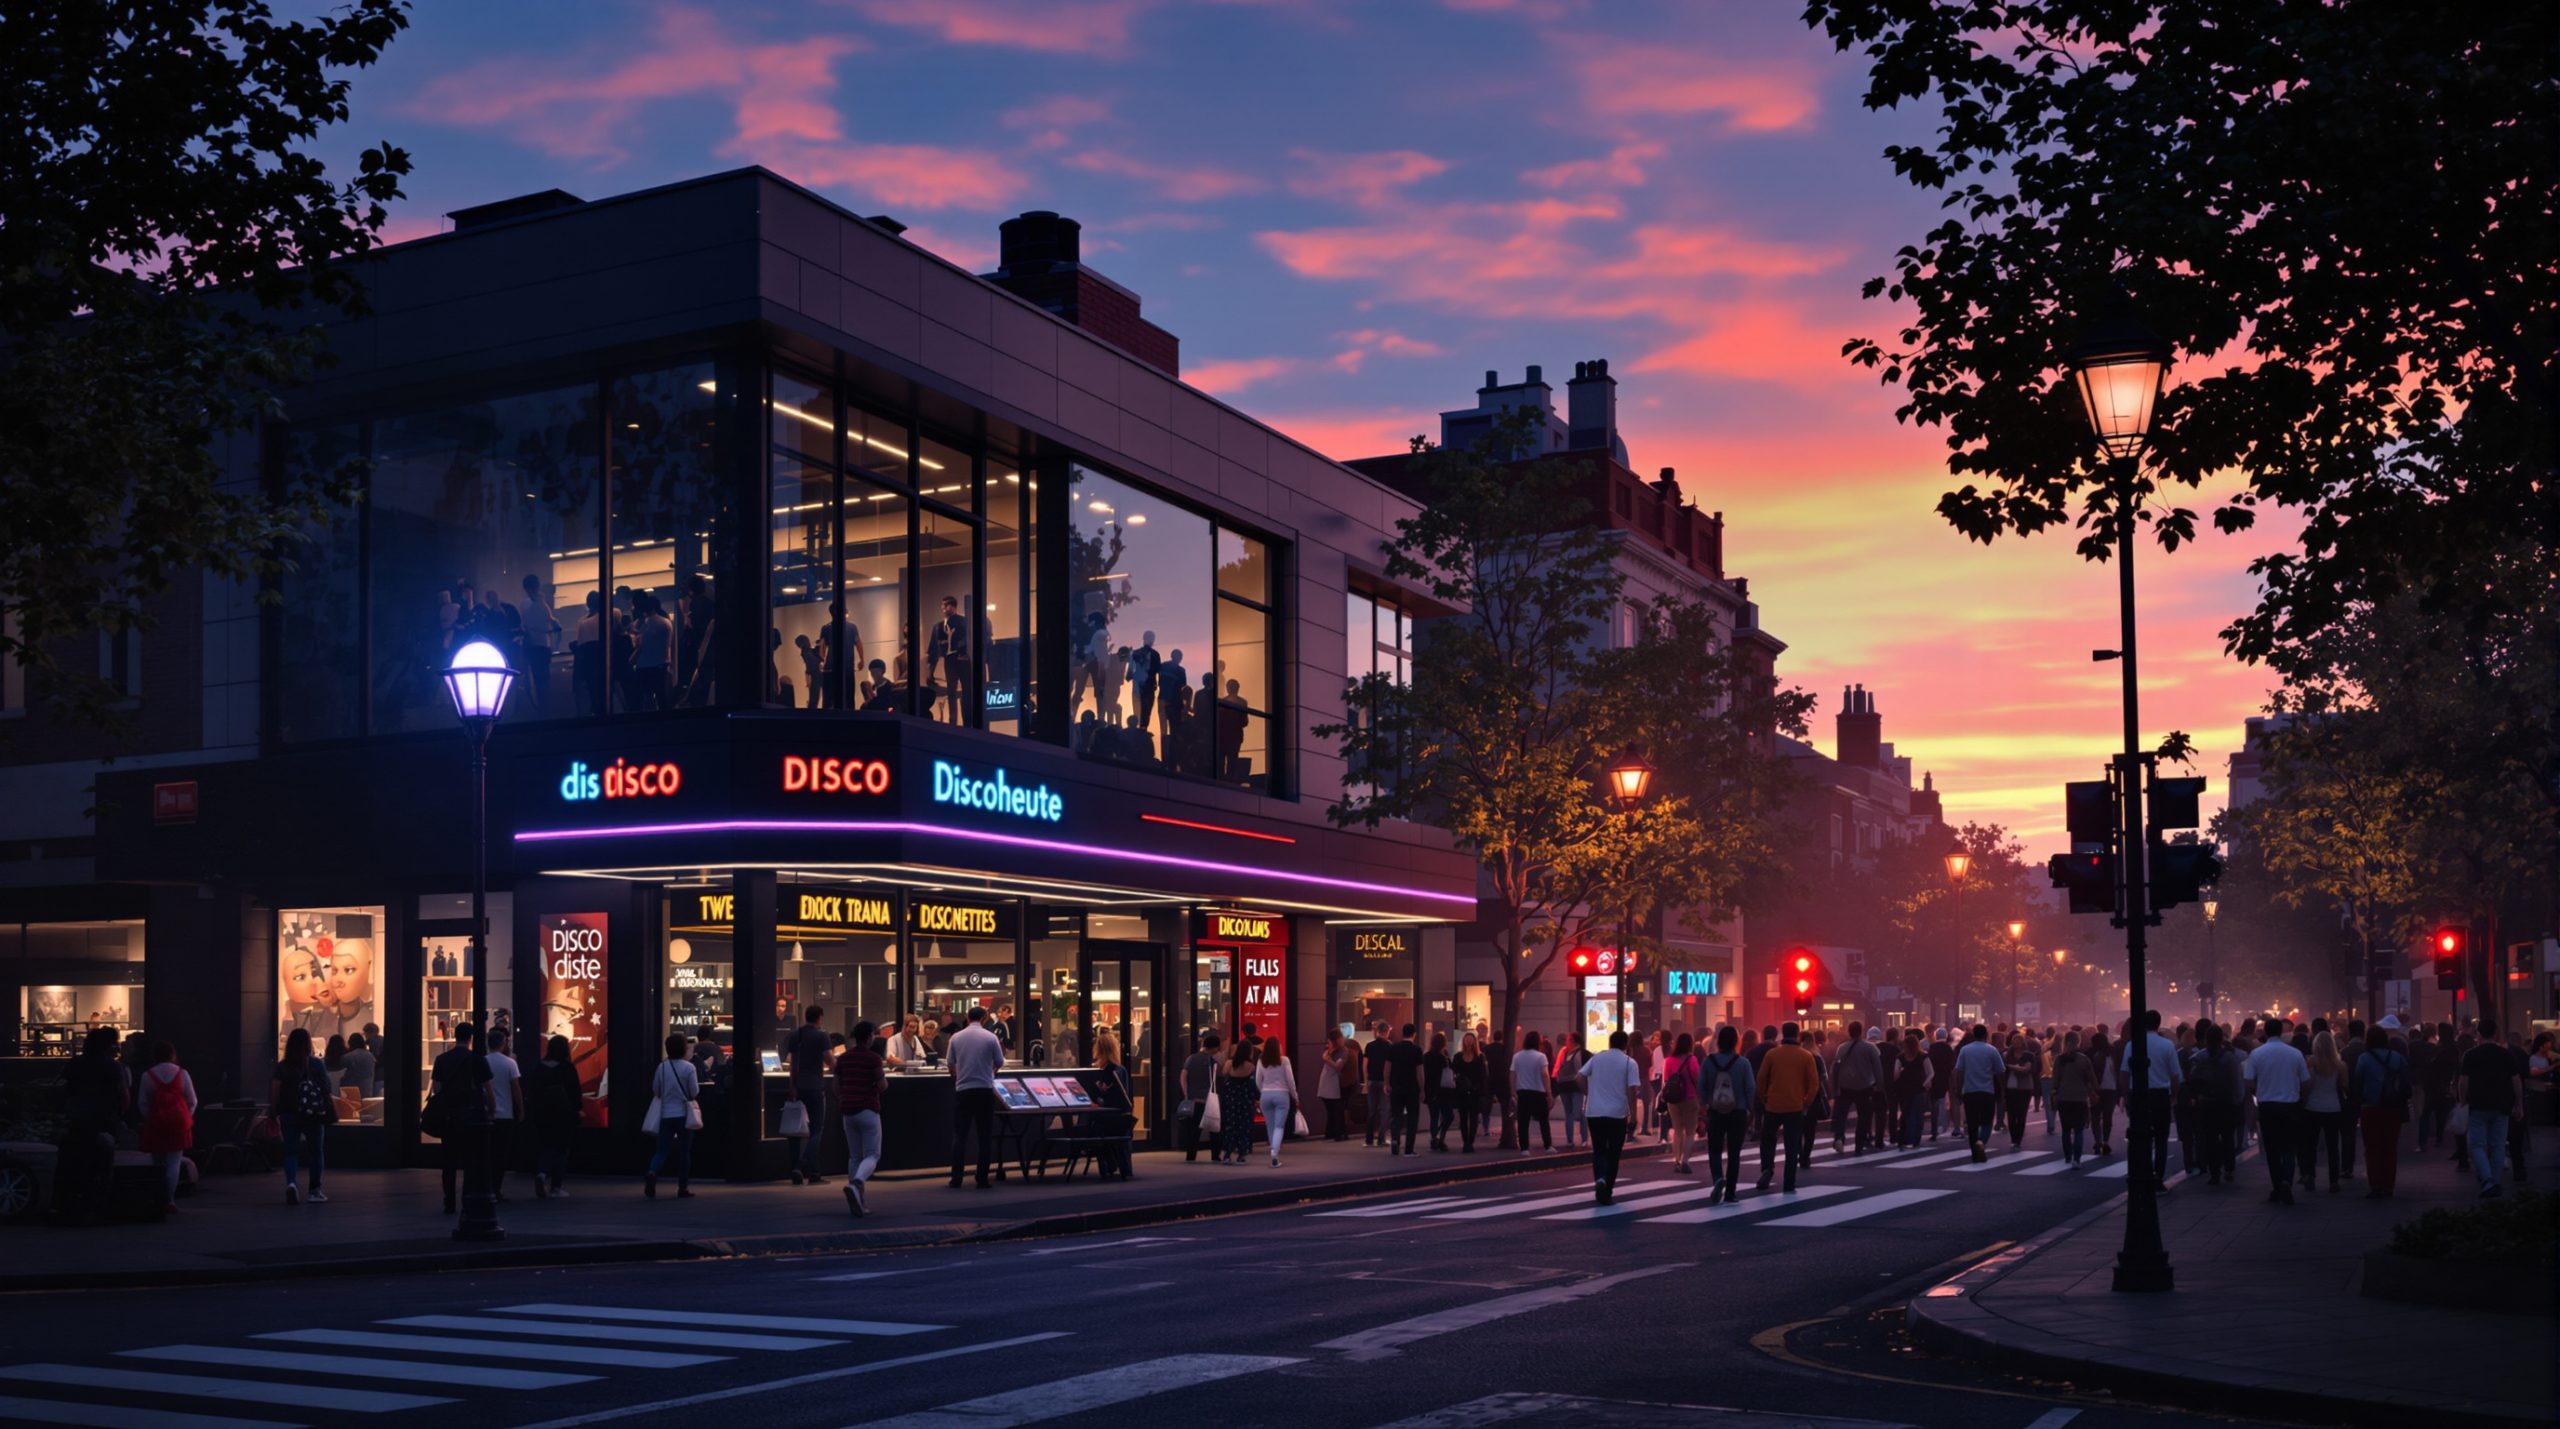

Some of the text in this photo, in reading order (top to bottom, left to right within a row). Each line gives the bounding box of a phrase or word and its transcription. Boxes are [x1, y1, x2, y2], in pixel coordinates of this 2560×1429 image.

[783, 756, 891, 796] DISCO
[934, 760, 1064, 821] Discoheute
[554, 952, 601, 980] diste
[1245, 985, 1280, 1005] AT AN
